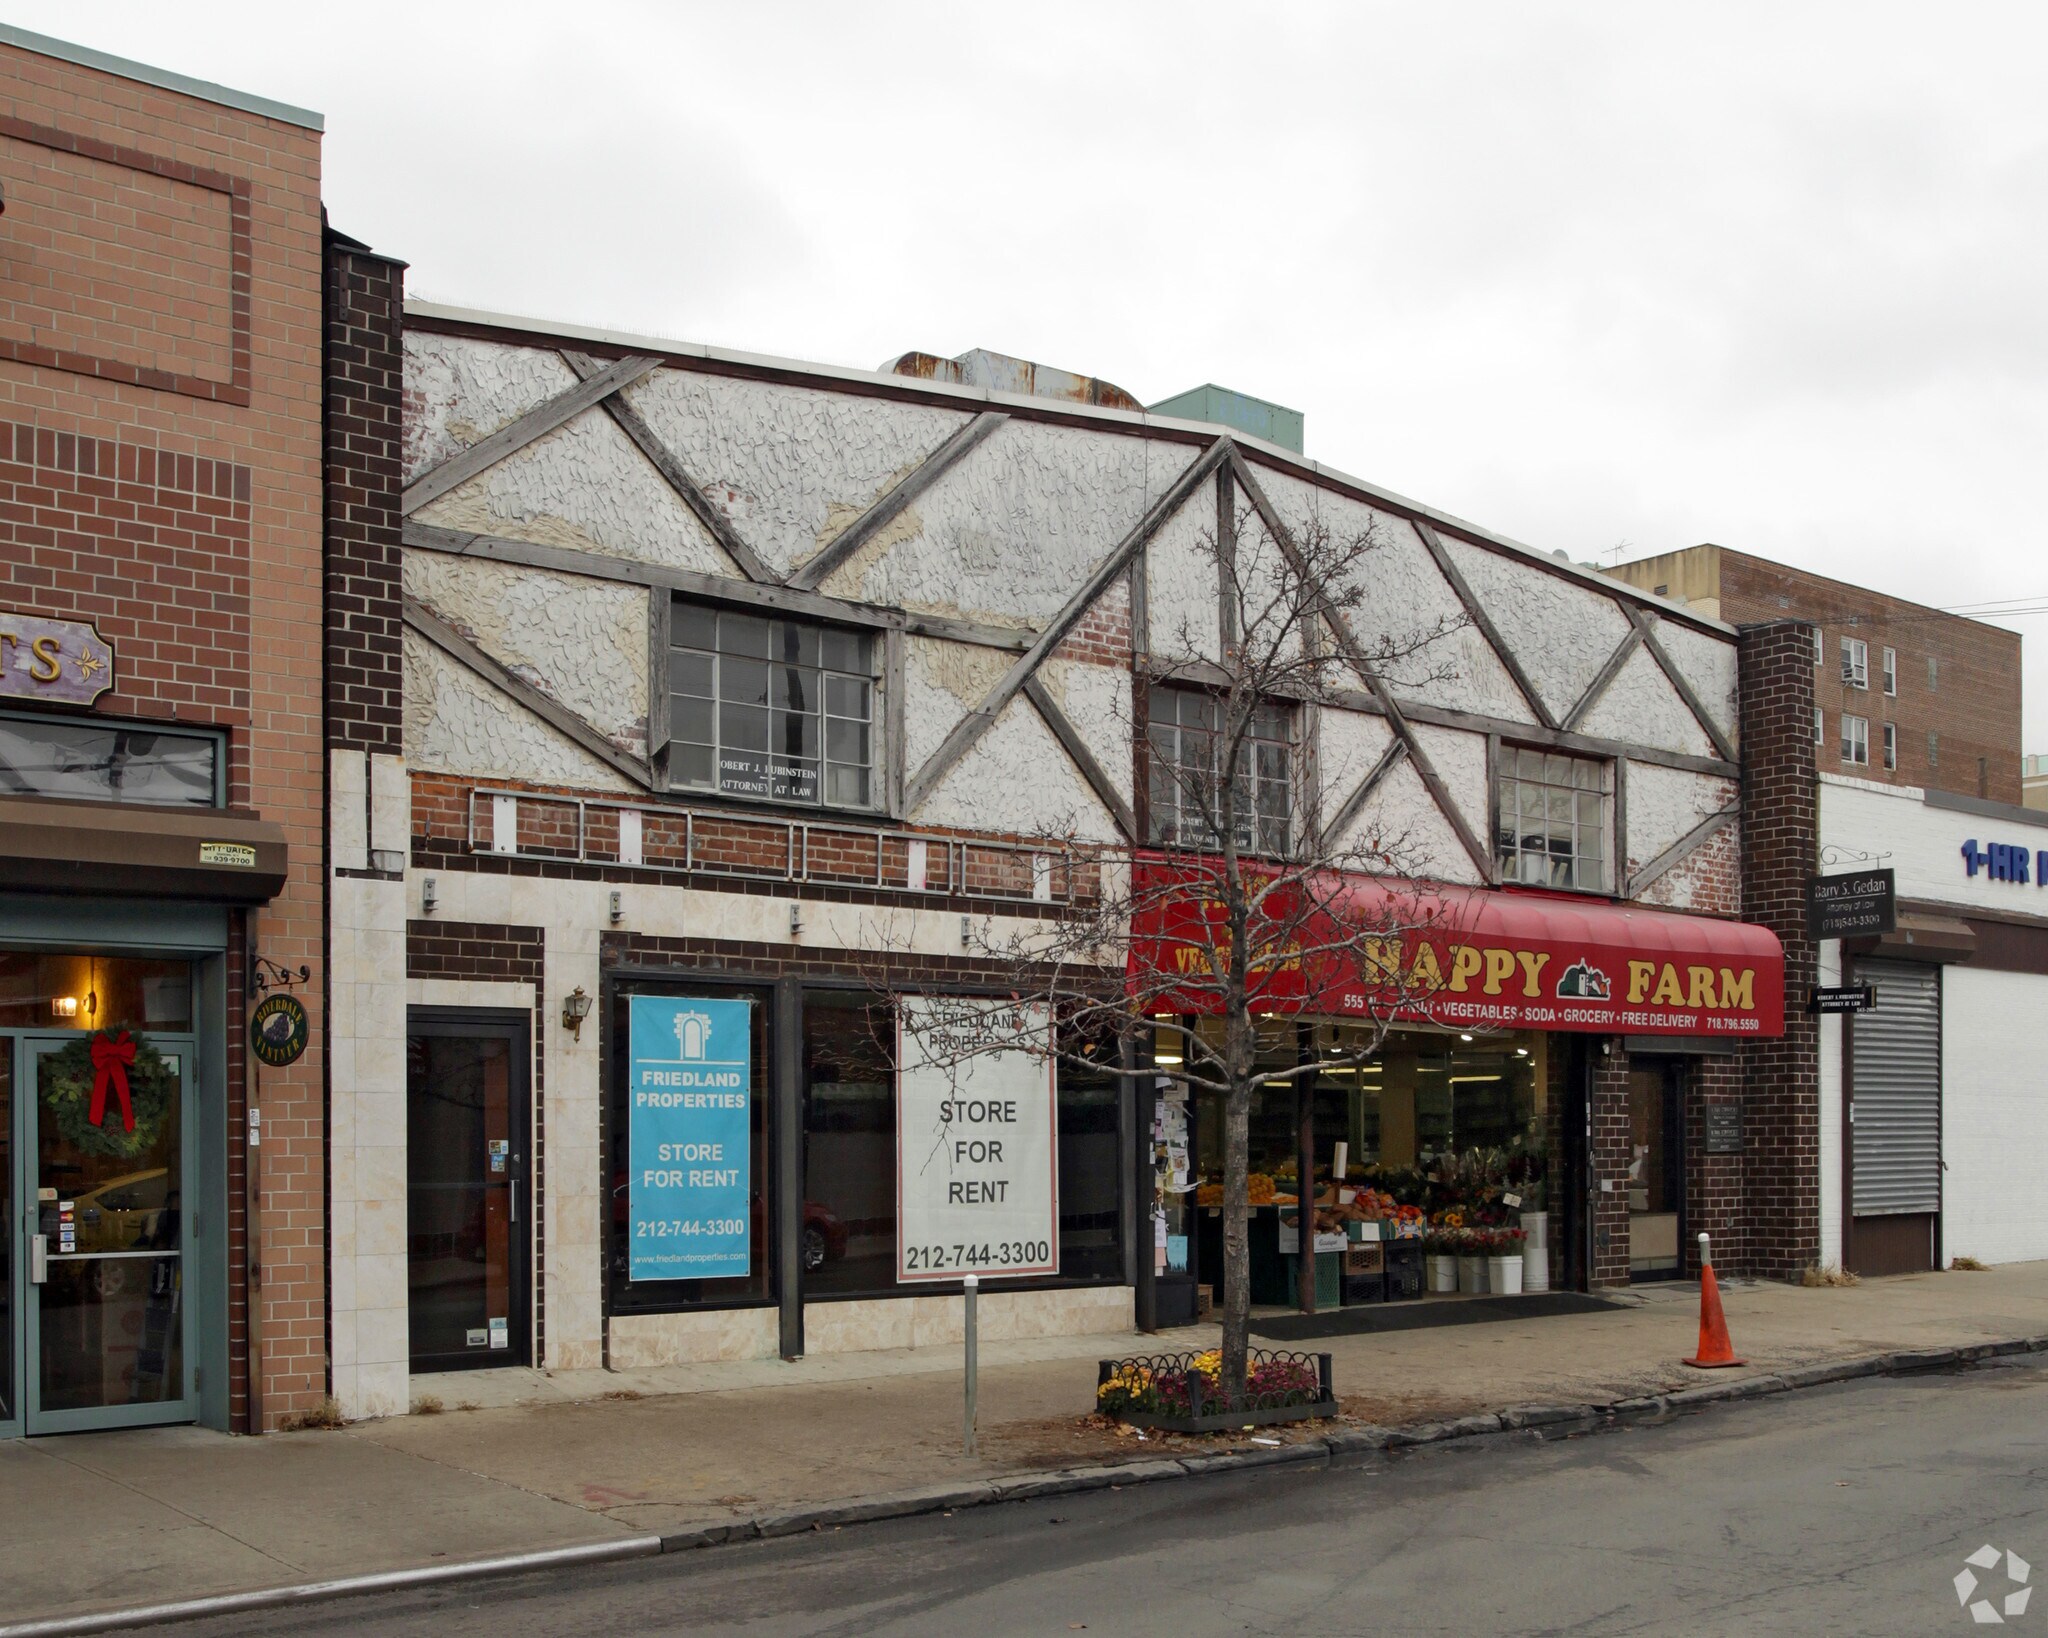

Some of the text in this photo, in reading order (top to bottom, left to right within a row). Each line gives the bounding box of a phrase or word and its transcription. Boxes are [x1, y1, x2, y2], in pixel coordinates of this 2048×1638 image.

[720, 760, 751, 772] OBERT
[754, 763, 761, 773] J.
[774, 785, 787, 795] AT
[792, 786, 811, 797] LAW
[213, 856, 250, 865] 939-9700
[1961, 838, 2030, 884] 1-HR
[1815, 879, 1886, 898] Barry S. Gedan
[1364, 937, 1755, 1010] HAPPY FARM
[1344, 994, 1364, 1008] 555
[1443, 1002, 1518, 1020] VEGETABLES
[1525, 1007, 1555, 1022] SODA
[1564, 1008, 1616, 1025] GROCERY
[1622, 1012, 1648, 1026] FREE
[1650, 1013, 1697, 1028] DELIVERY
[642, 1071, 741, 1087] FRIEDLAND
[636, 1092, 746, 1108] PROPERTIES
[940, 1101, 1017, 1123] STORE
[658, 1144, 723, 1161] STORE
[955, 1141, 1003, 1163] FOR
[644, 1169, 739, 1188] FOR RENT
[949, 1180, 1009, 1204] RENT
[636, 1219, 745, 1237] 212-744-3300
[634, 1253, 746, 1264] www.friedlandproperties.com
[907, 1240, 1049, 1270] 212-744-3300
